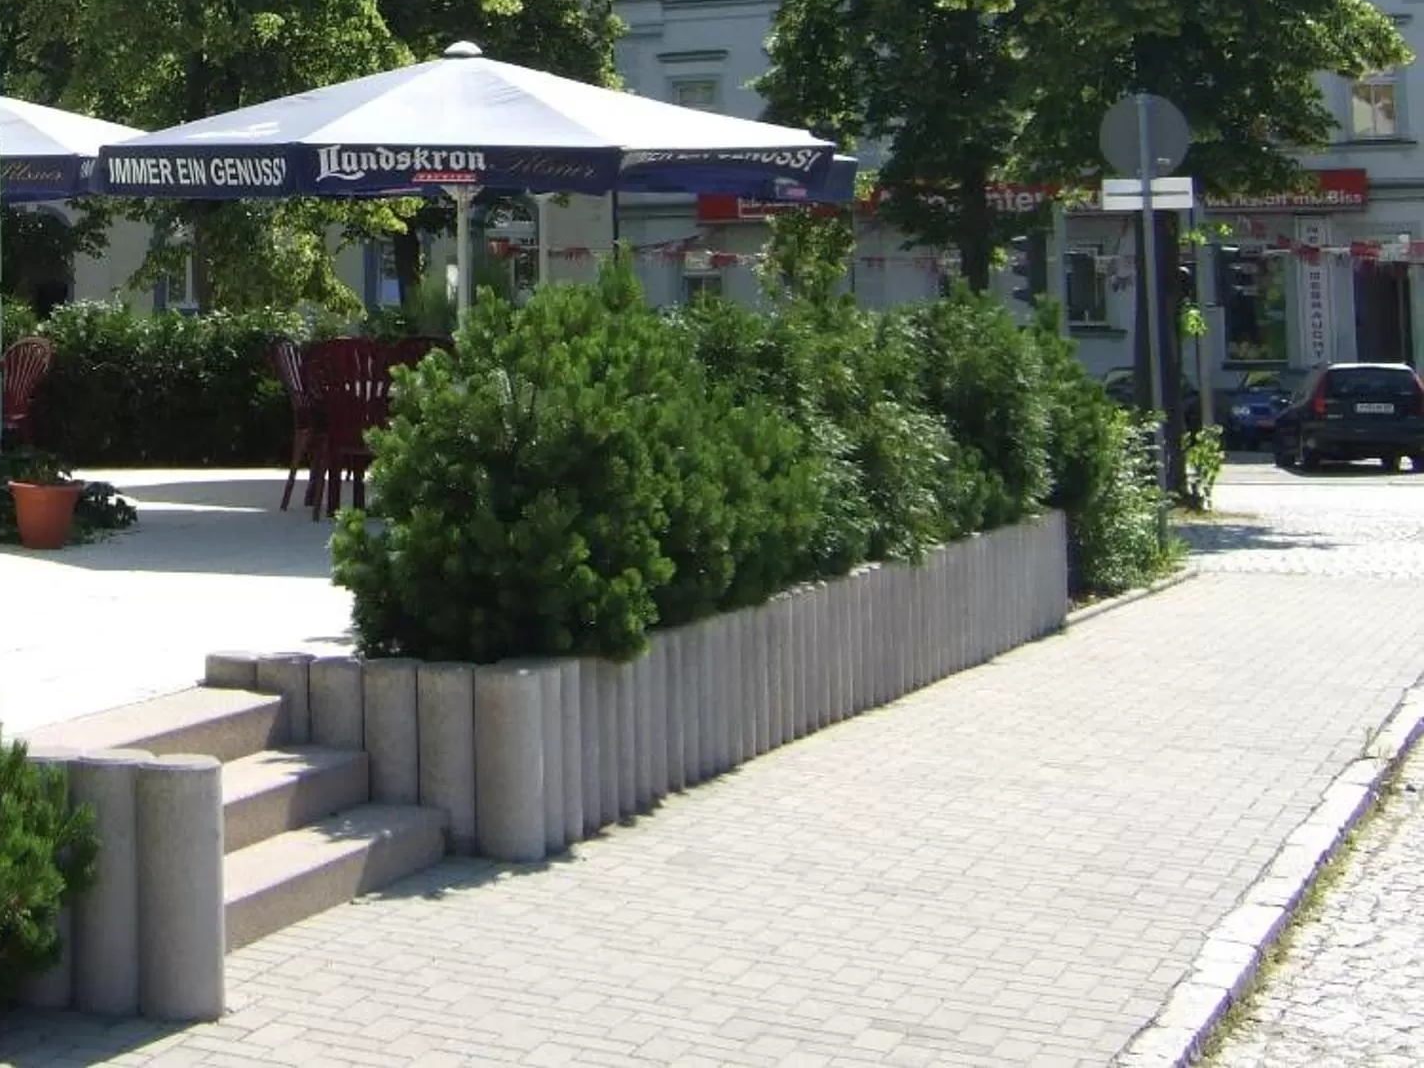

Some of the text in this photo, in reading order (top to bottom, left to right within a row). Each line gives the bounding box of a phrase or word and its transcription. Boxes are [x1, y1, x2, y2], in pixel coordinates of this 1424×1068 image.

[109, 157, 287, 187] IMMER EIN GENUSS!
[315, 144, 487, 182] Landskron
